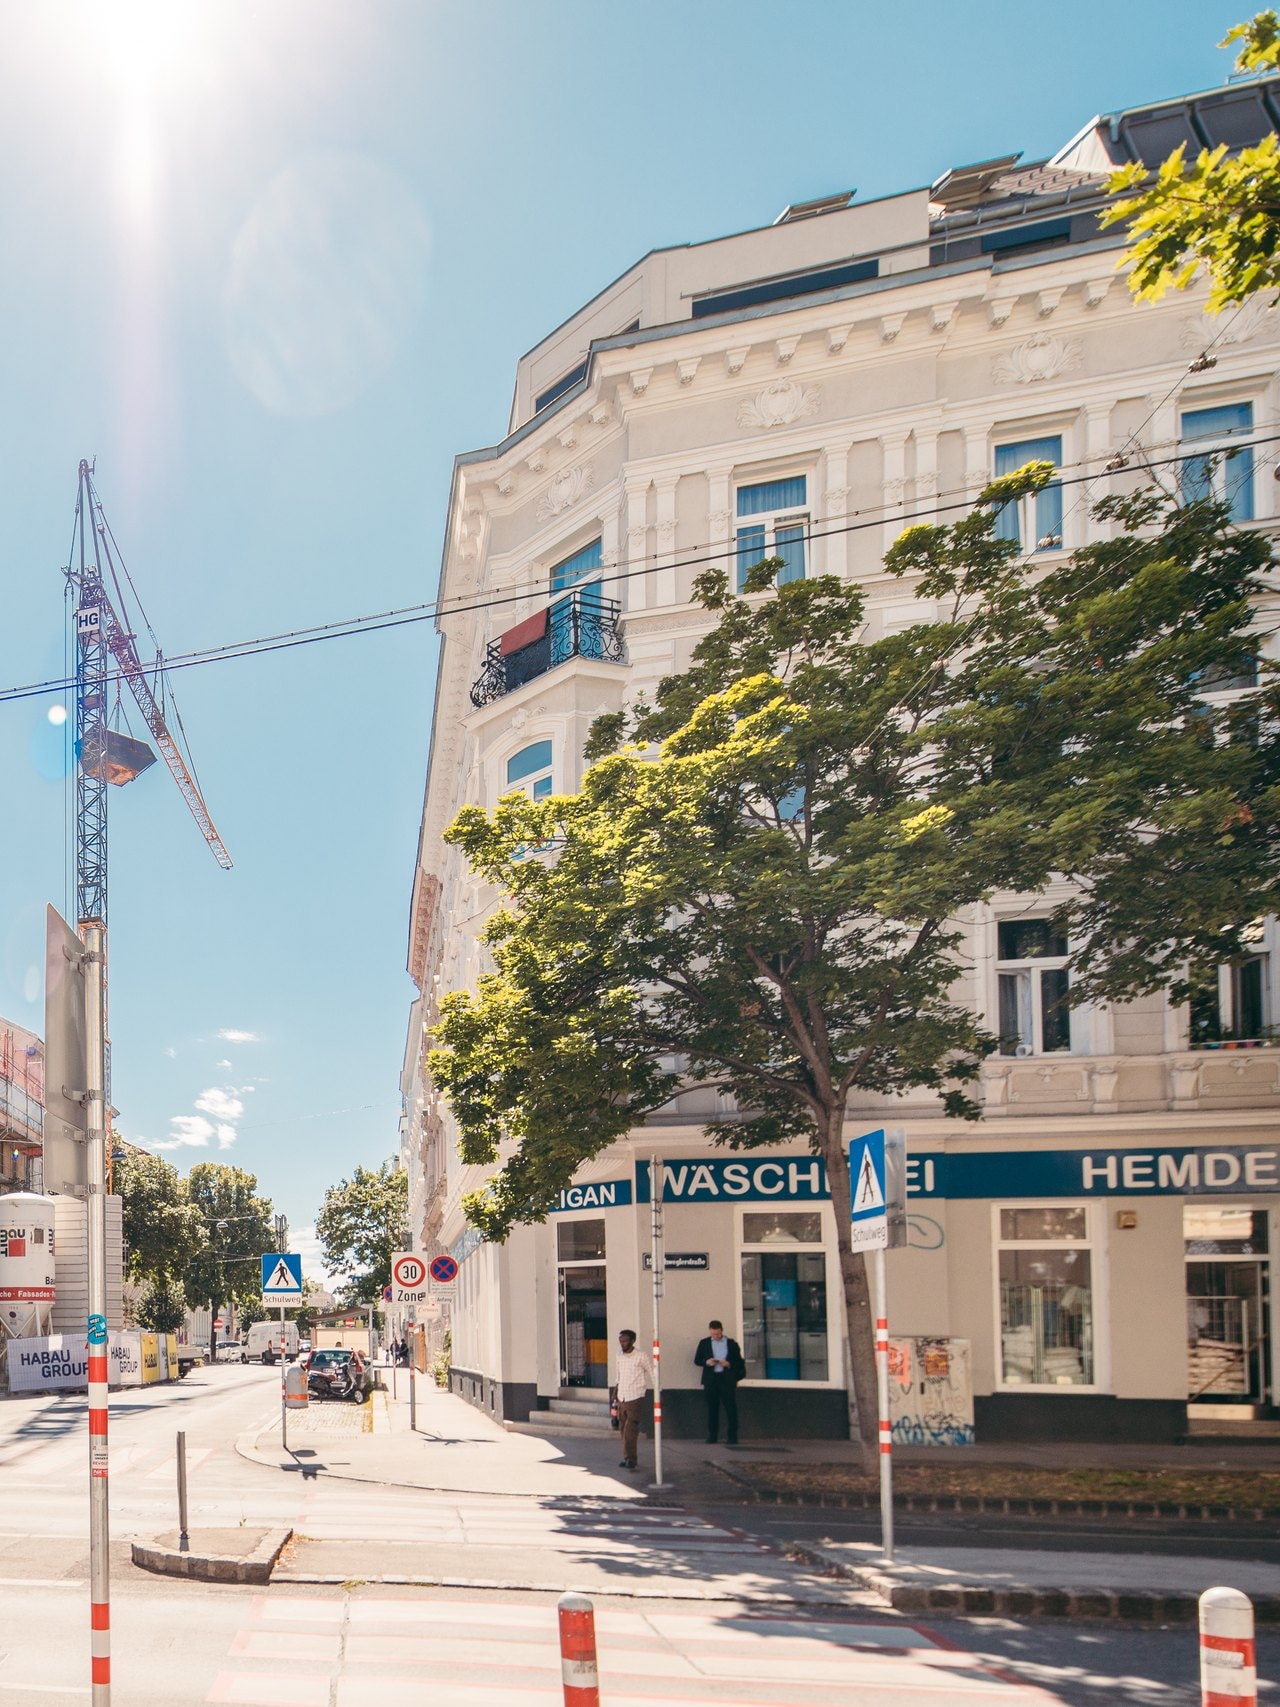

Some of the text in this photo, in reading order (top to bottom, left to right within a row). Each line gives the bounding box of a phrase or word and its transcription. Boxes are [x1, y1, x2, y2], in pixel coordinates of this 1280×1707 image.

[79, 612, 98, 628] HG
[647, 1159, 934, 1196] WÄSCHEI
[1082, 1152, 1279, 1190] HEMDE
[554, 1183, 616, 1209] IGAN
[853, 1226, 886, 1242] Schulweg
[402, 1265, 417, 1279] 30
[263, 1296, 301, 1304] Schulweg
[397, 1290, 424, 1302] Zone
[21, 1349, 71, 1366] HABAU
[111, 1347, 131, 1359] HABAU
[120, 1361, 138, 1373] GROUP
